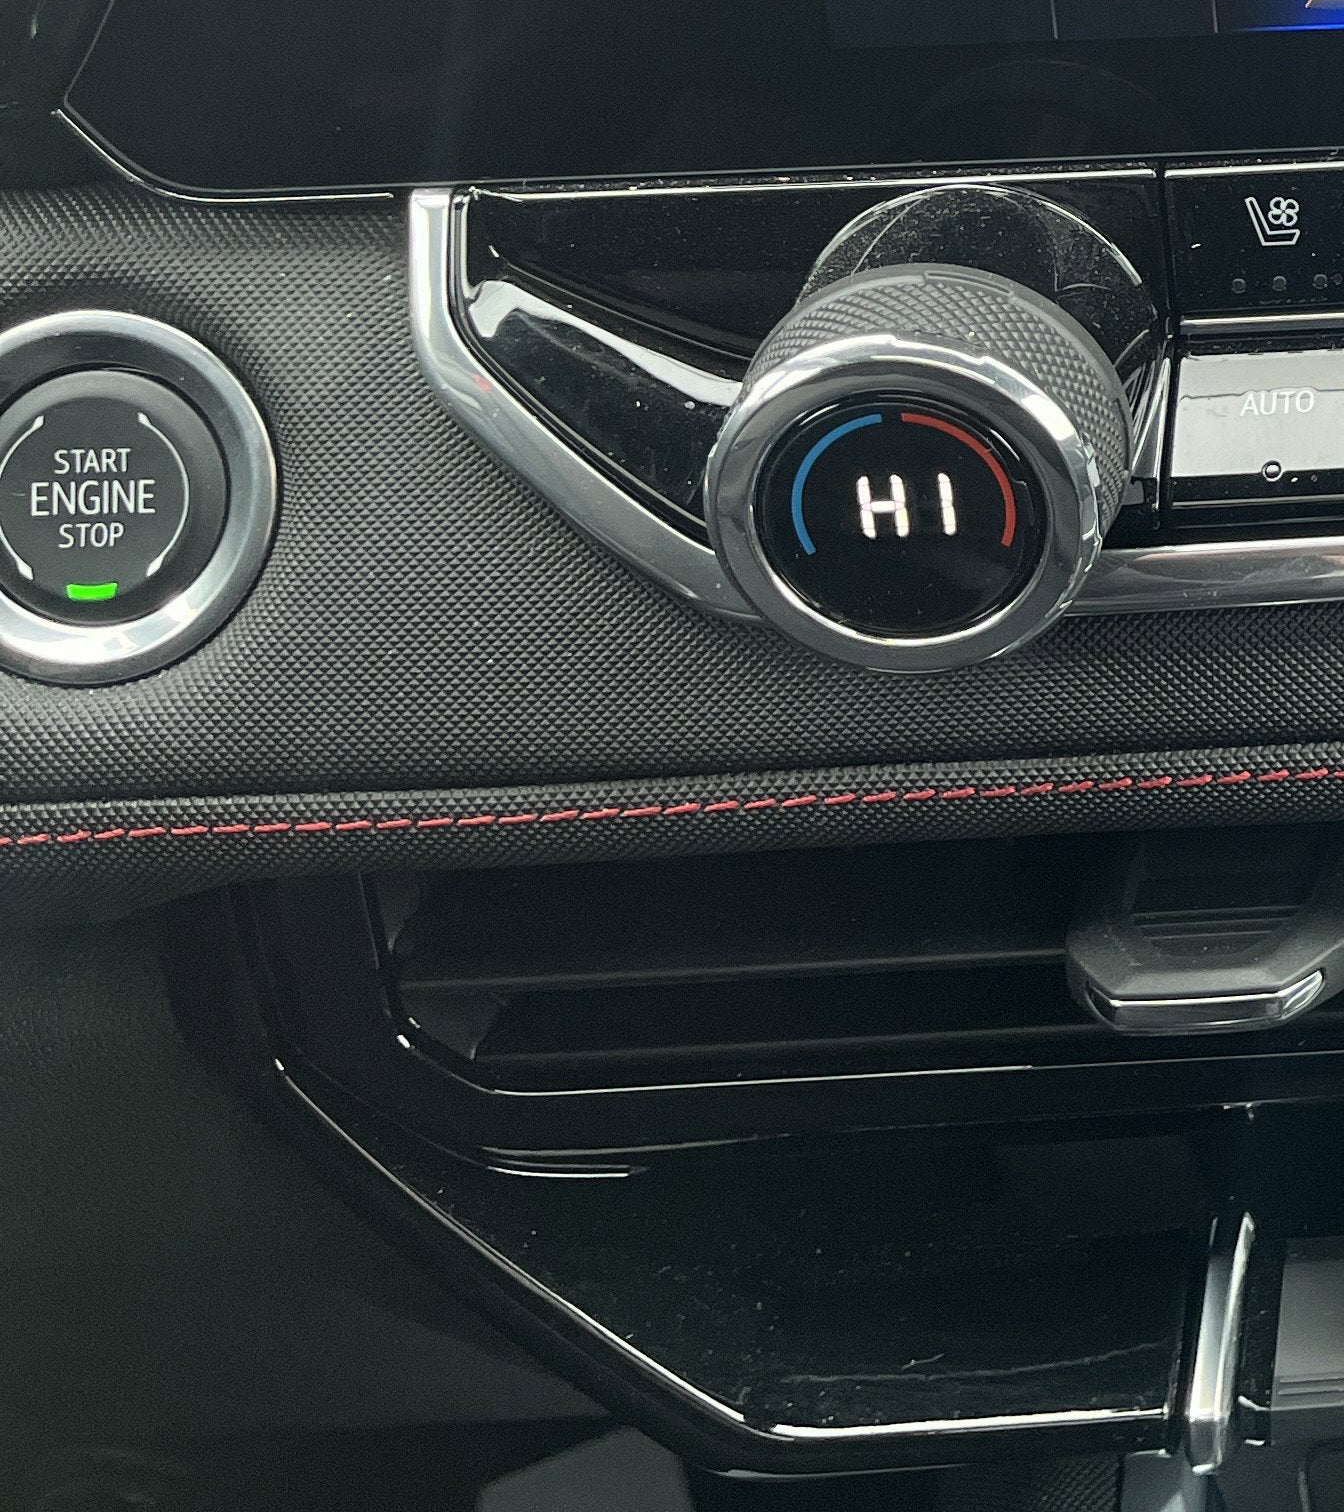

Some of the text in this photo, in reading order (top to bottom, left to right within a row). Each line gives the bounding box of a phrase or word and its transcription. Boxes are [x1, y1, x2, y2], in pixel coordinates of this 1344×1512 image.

[1240, 389, 1315, 417] AUTO
[53, 447, 132, 475] START
[30, 479, 156, 517] ENGINE
[856, 472, 957, 539] HI
[57, 522, 125, 549] STOP
